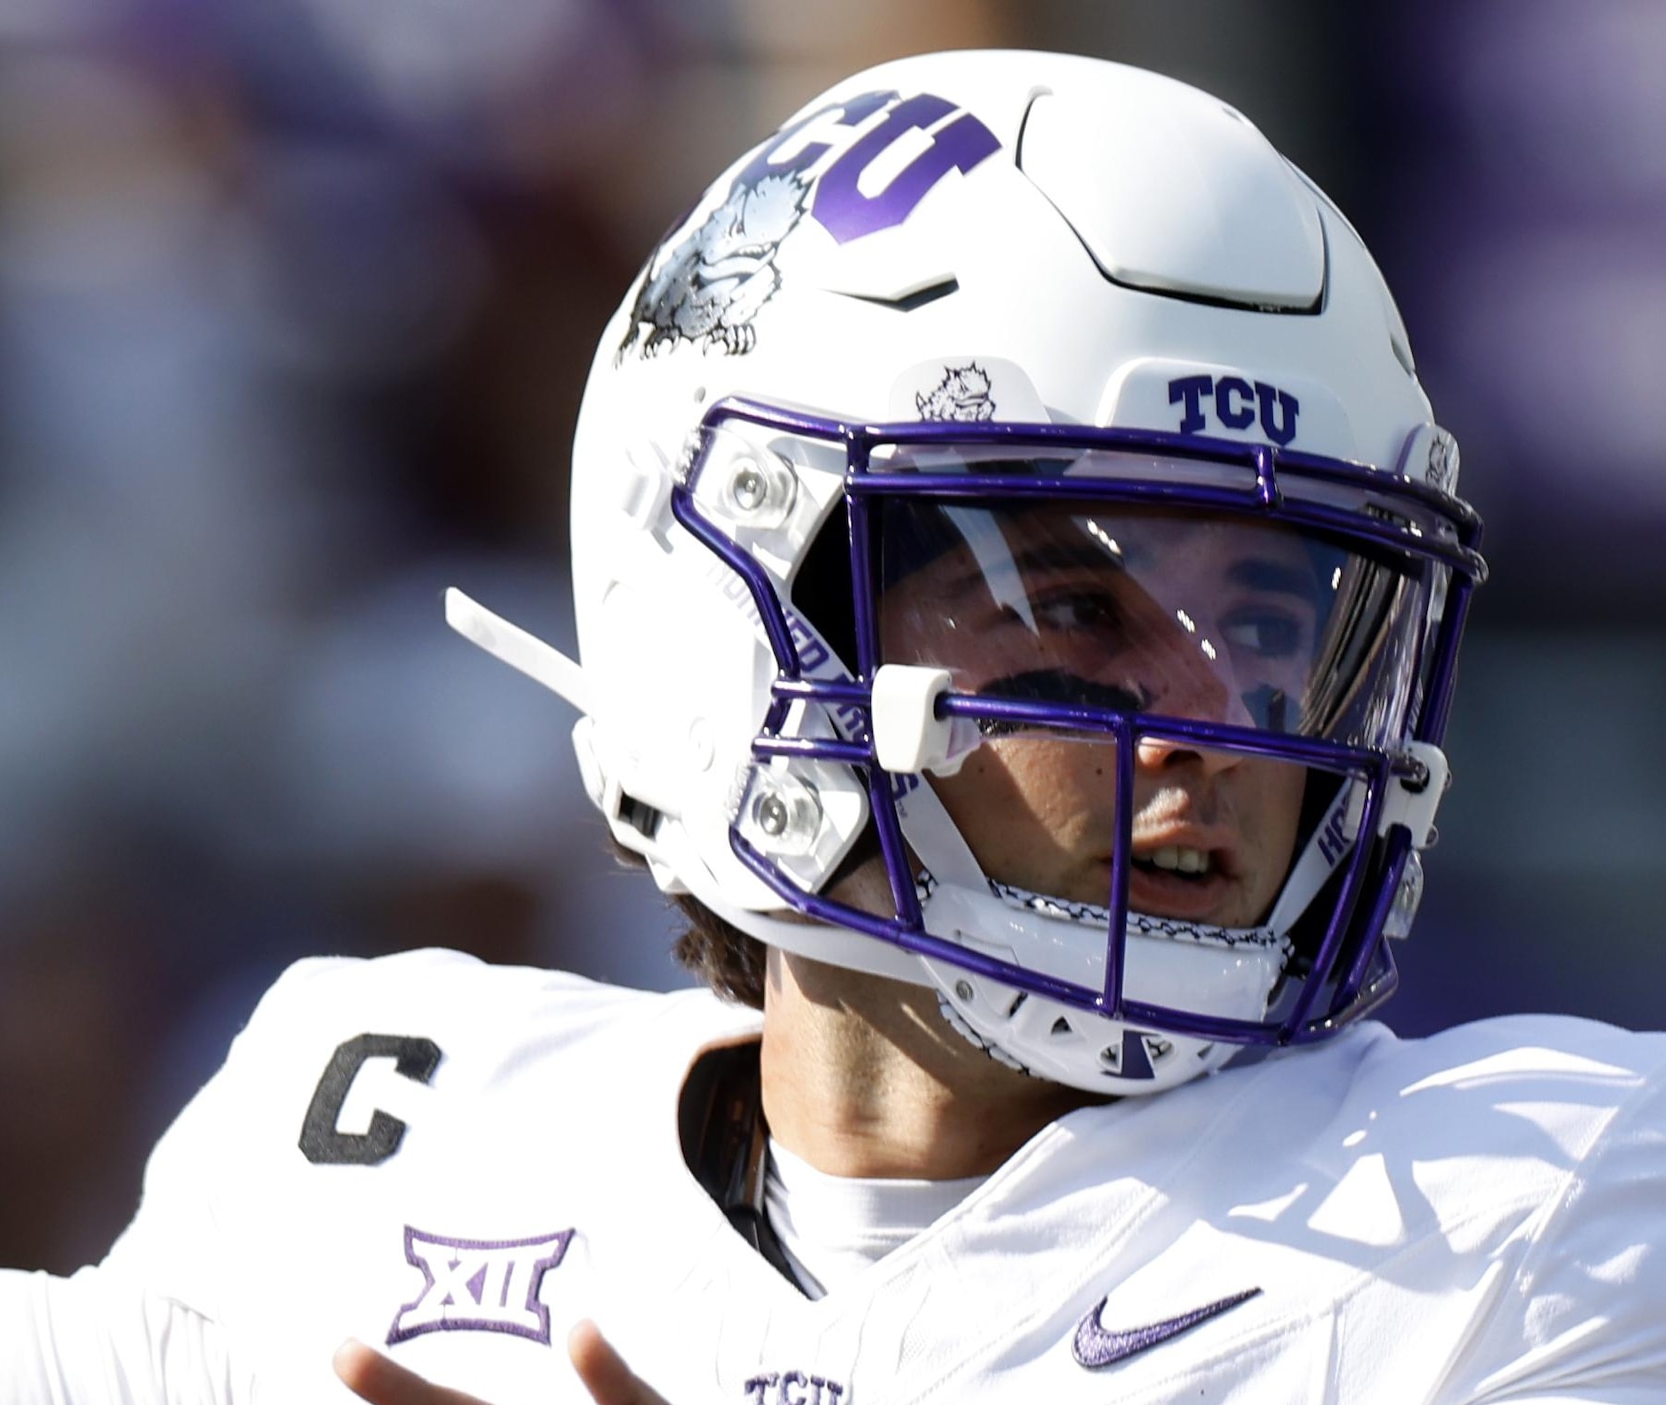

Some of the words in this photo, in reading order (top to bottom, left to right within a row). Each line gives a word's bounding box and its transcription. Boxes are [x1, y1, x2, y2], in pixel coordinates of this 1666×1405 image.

[659, 90, 1002, 245] CU
[1168, 374, 1300, 447] TCU
[299, 1033, 442, 1166] C
